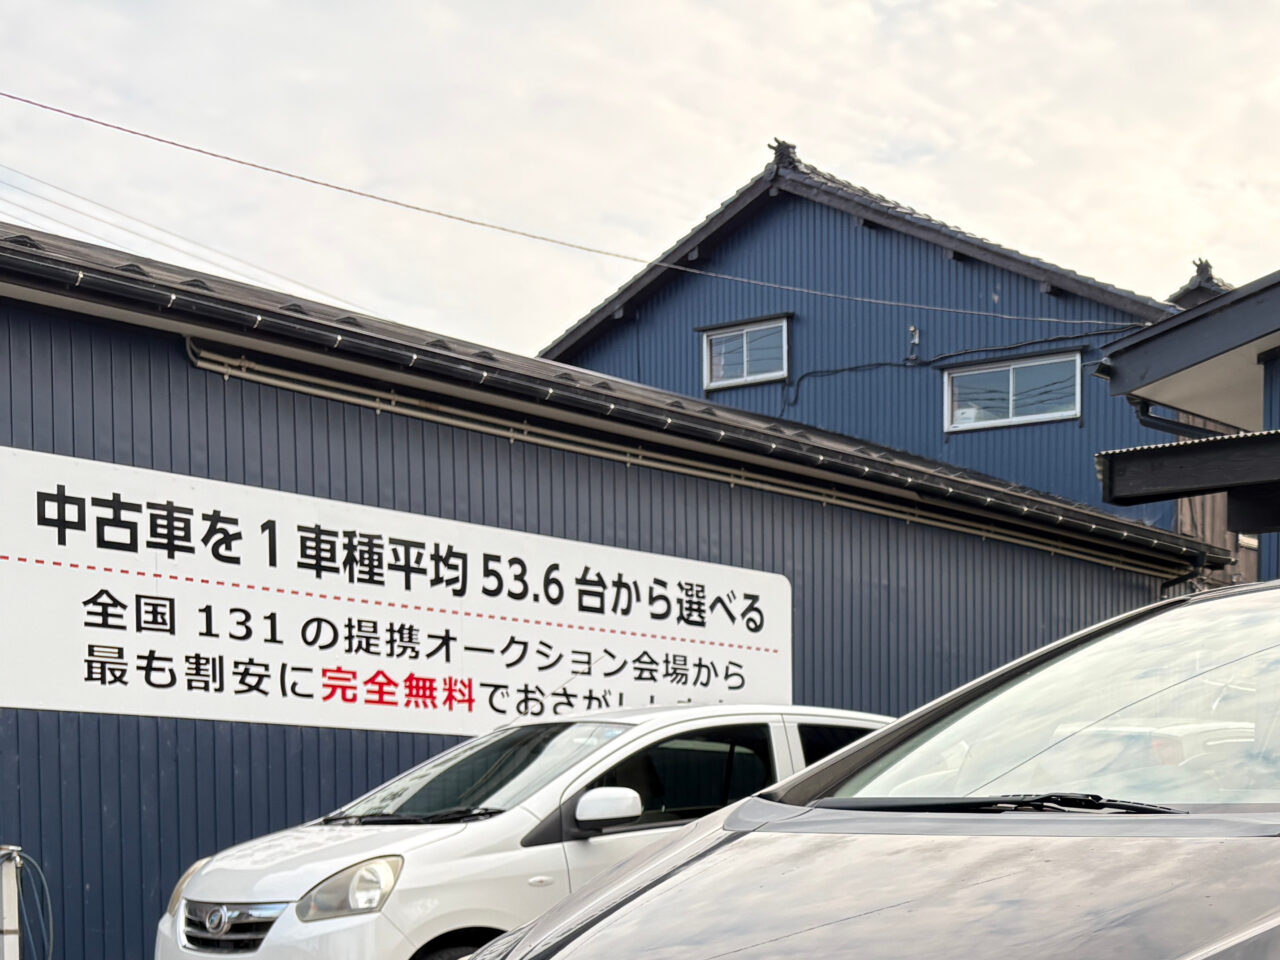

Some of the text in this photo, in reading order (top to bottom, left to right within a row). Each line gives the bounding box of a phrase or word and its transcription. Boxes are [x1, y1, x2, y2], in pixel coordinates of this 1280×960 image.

[84, 643, 723, 717] 最も割安に完全無料でおさが
